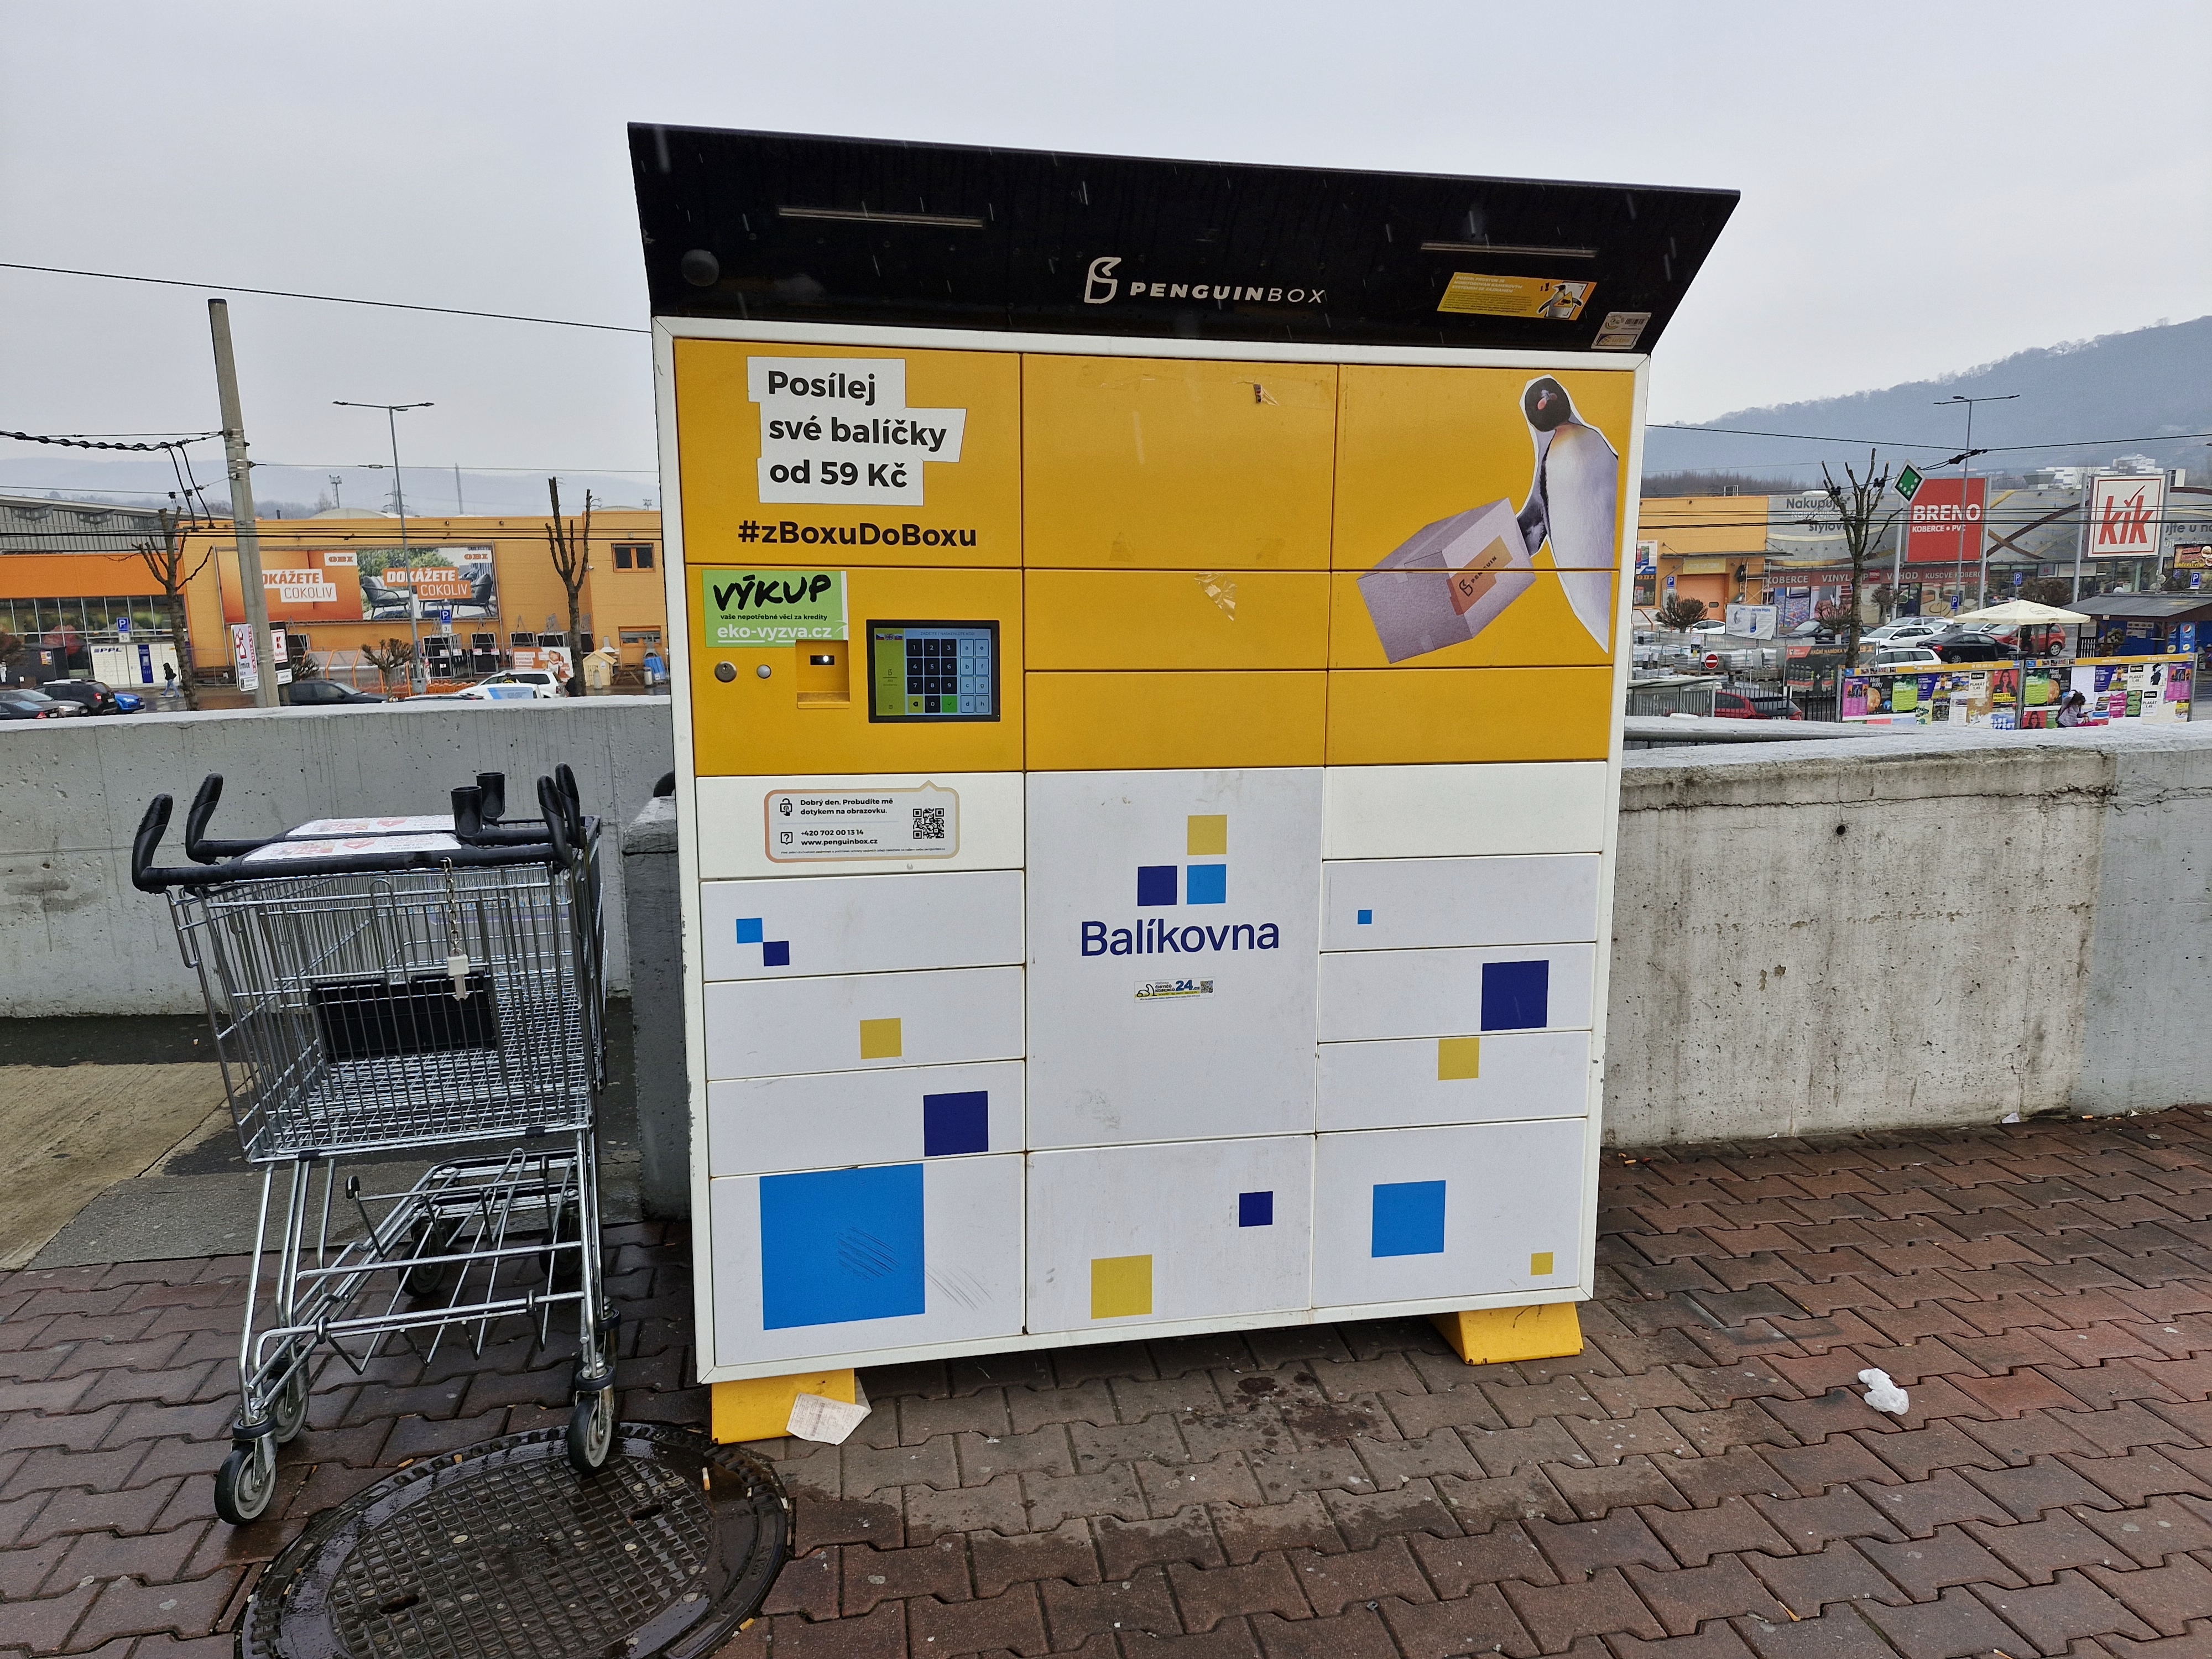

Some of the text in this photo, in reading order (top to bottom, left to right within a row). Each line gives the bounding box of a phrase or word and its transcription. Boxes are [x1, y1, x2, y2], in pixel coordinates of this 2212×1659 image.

[1130, 282, 1325, 303] PENGUINBOX
[768, 371, 875, 406] Posílej
[769, 415, 947, 452] své balíčky
[770, 459, 907, 488] od 59 Kč
[1912, 504, 1981, 523] BRENO
[738, 520, 976, 546] #zBoxuDoBoxu
[262, 571, 320, 585] OKÁŽETE
[1471, 556, 1497, 583] PENUIN
[1887, 571, 1918, 580] VHOD
[1925, 571, 1953, 579] KUSOVÉ
[284, 587, 332, 598] COKOLIV
[420, 583, 468, 596] COKOLIV
[713, 574, 831, 611] VÝKUP
[119, 619, 126, 628] P
[442, 611, 448, 619] P
[717, 624, 832, 641] eko-vyzva.cz
[800, 799, 823, 807] Dobrý
[801, 838, 878, 847] www.penguinbox.cz
[1081, 918, 1279, 957] Balíkovna
